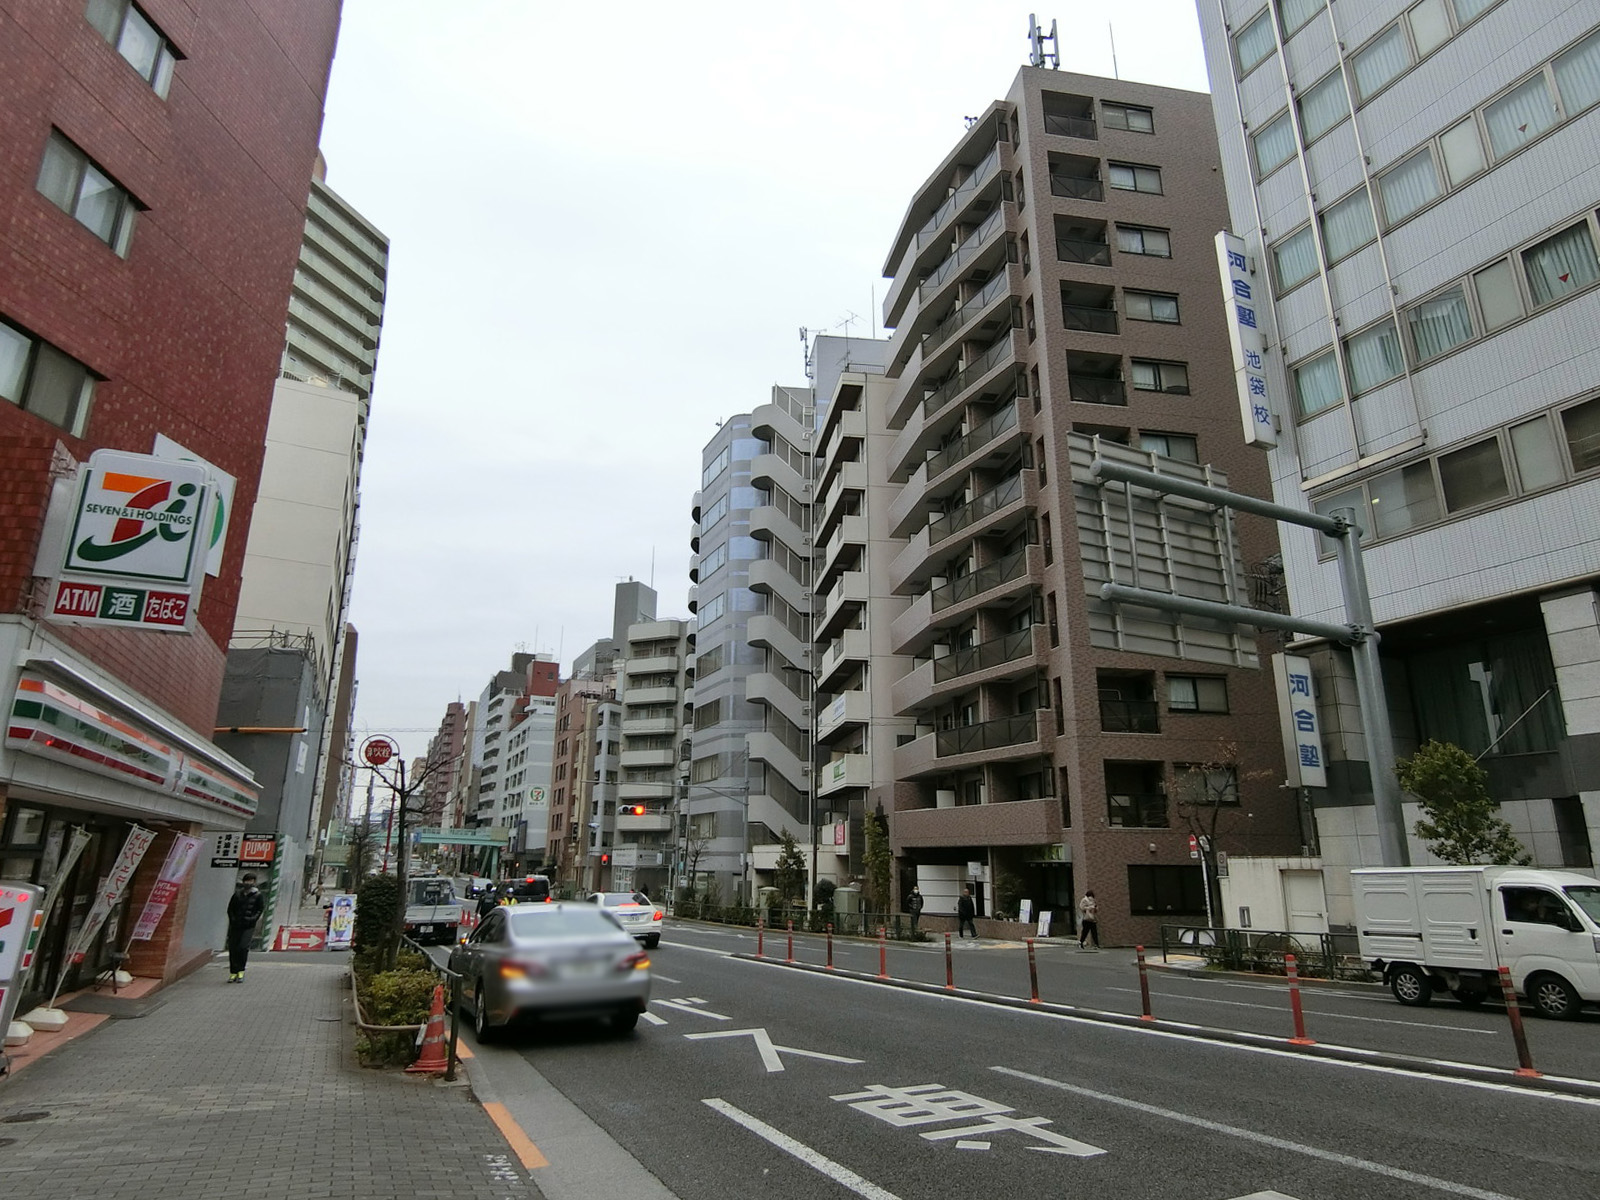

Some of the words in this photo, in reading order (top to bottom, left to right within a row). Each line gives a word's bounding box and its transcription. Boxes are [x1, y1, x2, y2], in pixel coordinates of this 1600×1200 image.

[1228, 250, 1257, 329] 河合塾
[1245, 349, 1271, 425] 池袋校
[137, 510, 193, 525] HOLDINGS
[57, 588, 99, 612] ATM
[108, 592, 138, 616] 酒
[146, 597, 186, 620] たばこ
[1289, 673, 1320, 768] 河合塾
